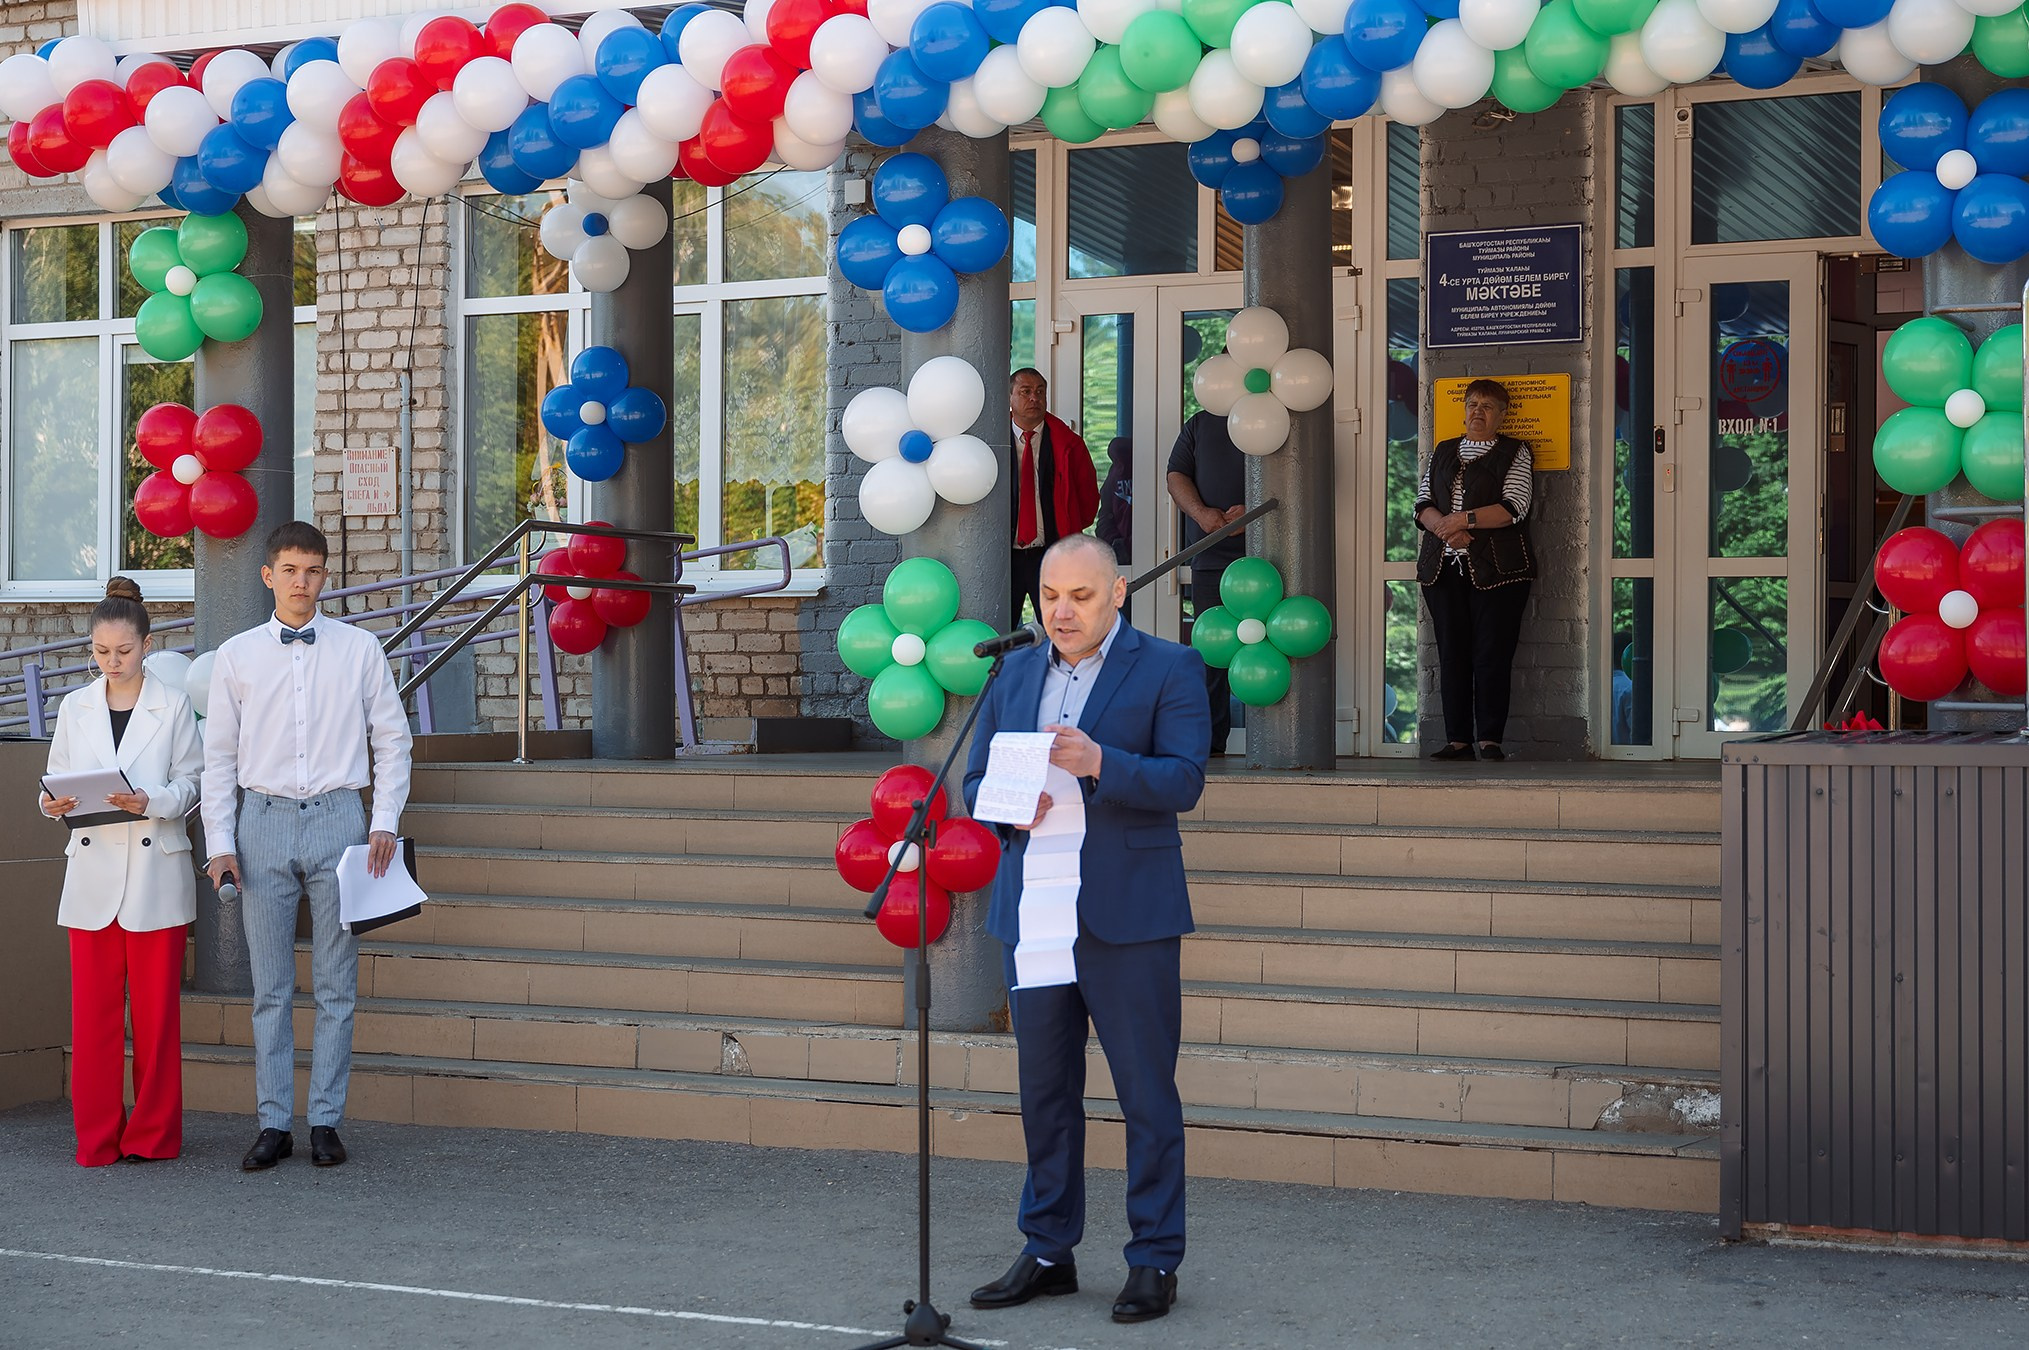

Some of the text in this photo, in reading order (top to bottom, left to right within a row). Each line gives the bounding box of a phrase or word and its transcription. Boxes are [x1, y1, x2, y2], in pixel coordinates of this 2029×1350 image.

[1472, 253, 1511, 261] МУНИЦИПАЛЬ
[1439, 273, 1460, 286] 4-СЕ
[1462, 277, 1481, 286] УРТА
[1482, 275, 1513, 285] ДӨЙӨМ
[1514, 273, 1541, 283] БЕЛЕМ
[1466, 284, 1542, 301] МӘКТӘБЕ
[1451, 305, 1490, 313] МУНИЦИПАЛЬ
[1718, 418, 1754, 436] ВХОД
[349, 461, 388, 474] ОПАСНЫЙ
[358, 476, 380, 487] СХОД
[347, 490, 370, 500] СНЕГА
